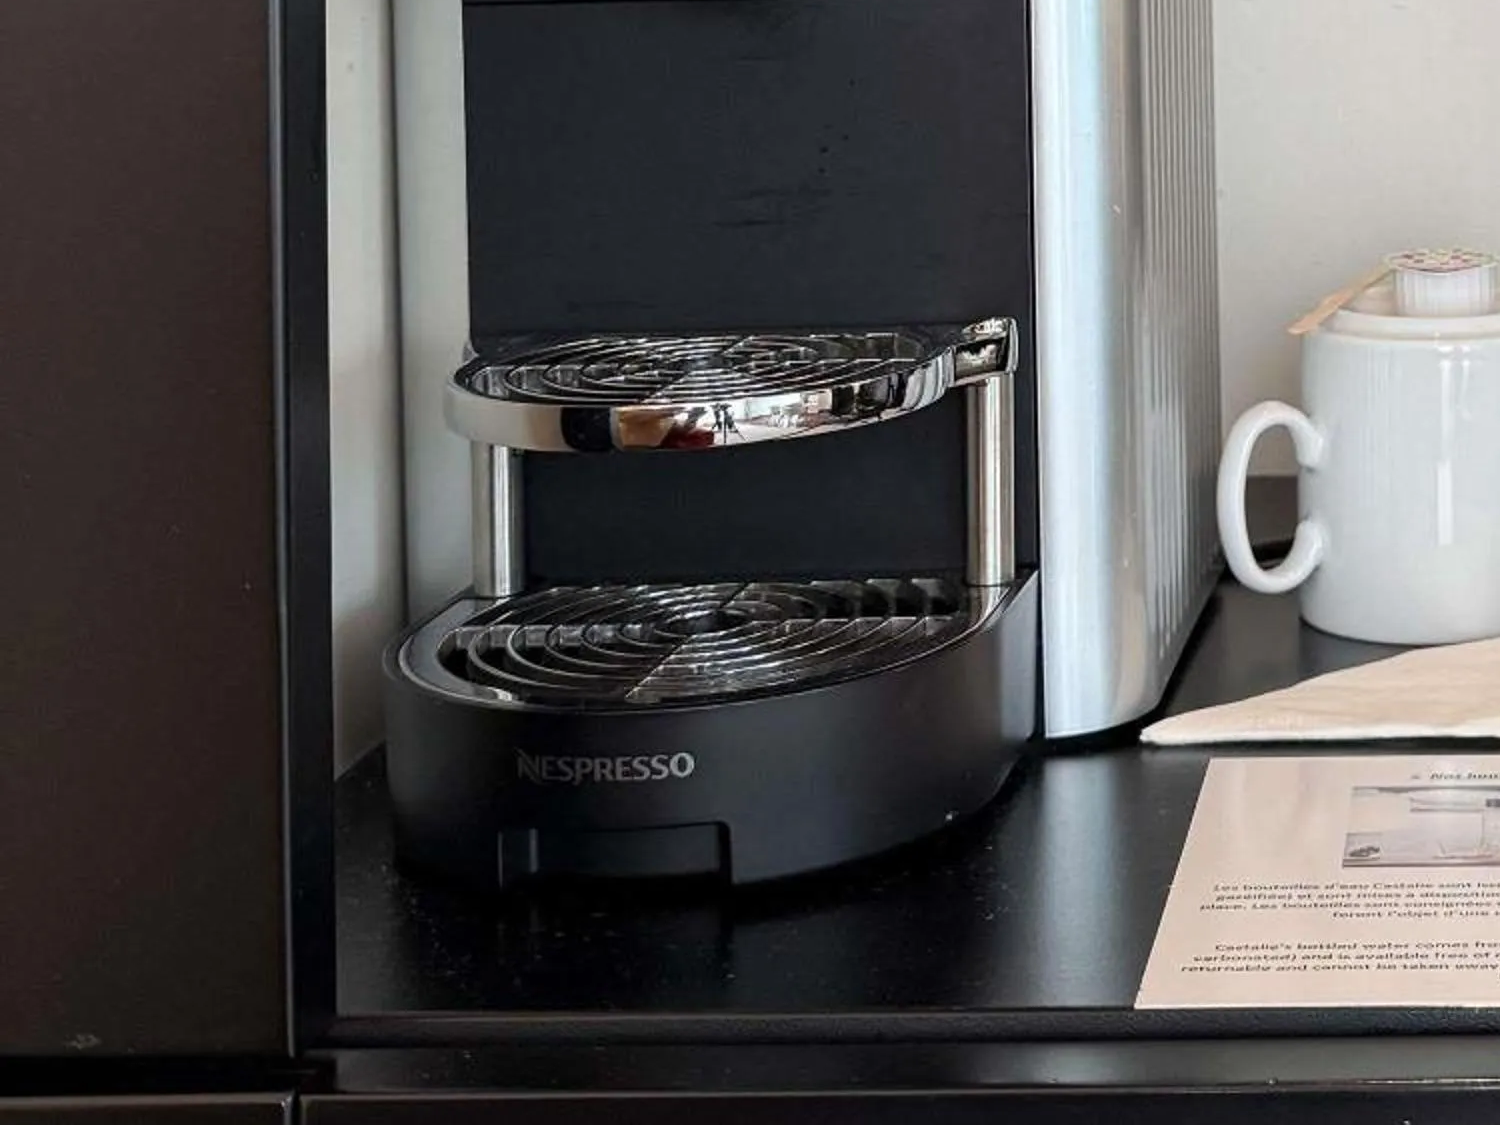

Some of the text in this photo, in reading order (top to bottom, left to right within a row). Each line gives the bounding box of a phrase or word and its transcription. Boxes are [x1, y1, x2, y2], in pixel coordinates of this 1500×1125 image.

[514, 747, 696, 786] NESPRESSO
[1213, 883, 1239, 892] Les
[1243, 882, 1320, 891] bouteilles
[1438, 881, 1471, 889] sont
[1357, 891, 1401, 899] mises
[1252, 902, 1278, 910] Les
[1283, 901, 1360, 909] bouteilles
[1404, 900, 1491, 908] consignées
[1387, 909, 1437, 918] l'objet
[1443, 909, 1490, 917] d'une
[1297, 942, 1357, 950] bottled
[1193, 953, 1297, 962] carbonated)
[1355, 952, 1430, 960] available
[1435, 951, 1469, 959] free
[1181, 963, 1271, 972] returnable
[1275, 963, 1308, 971] and
[1376, 962, 1398, 970] be
[1402, 962, 1450, 970] taken
